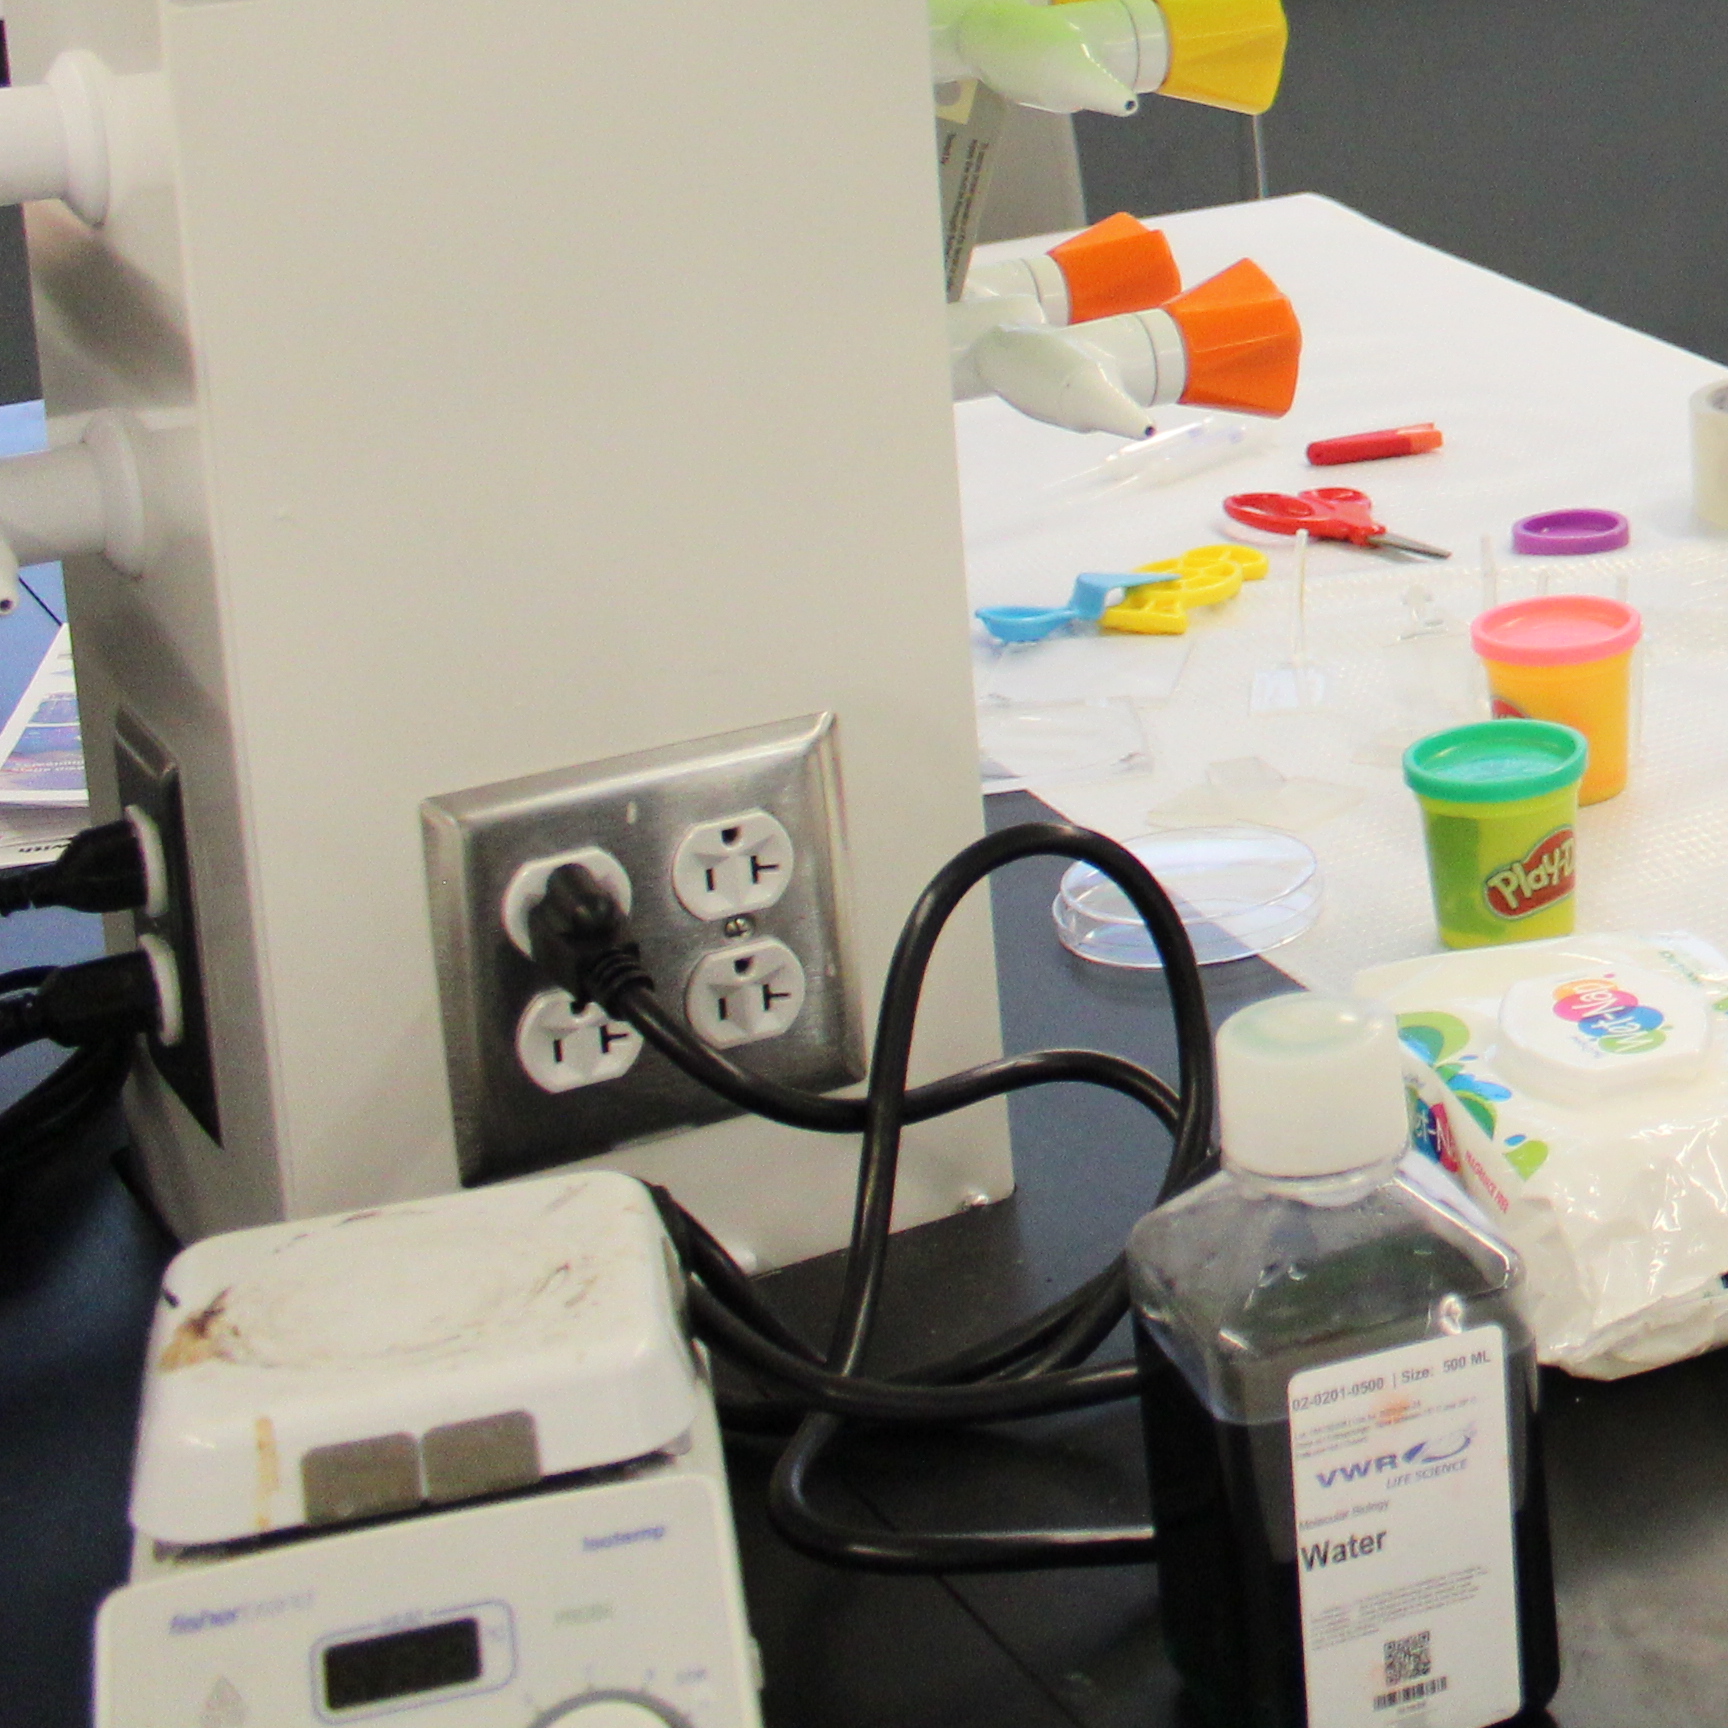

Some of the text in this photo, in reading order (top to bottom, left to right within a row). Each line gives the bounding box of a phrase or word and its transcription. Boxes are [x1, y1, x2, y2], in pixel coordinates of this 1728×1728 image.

[1571, 982, 1654, 1052] Wet-Nap
[1401, 1367, 1433, 1384] Size:
[1443, 1356, 1467, 1373] 500
[1471, 1350, 1491, 1366] ML
[1316, 1453, 1398, 1488] VWR
[1386, 1458, 1467, 1489] LIFE SCIENCE
[1300, 1530, 1387, 1572] Water
